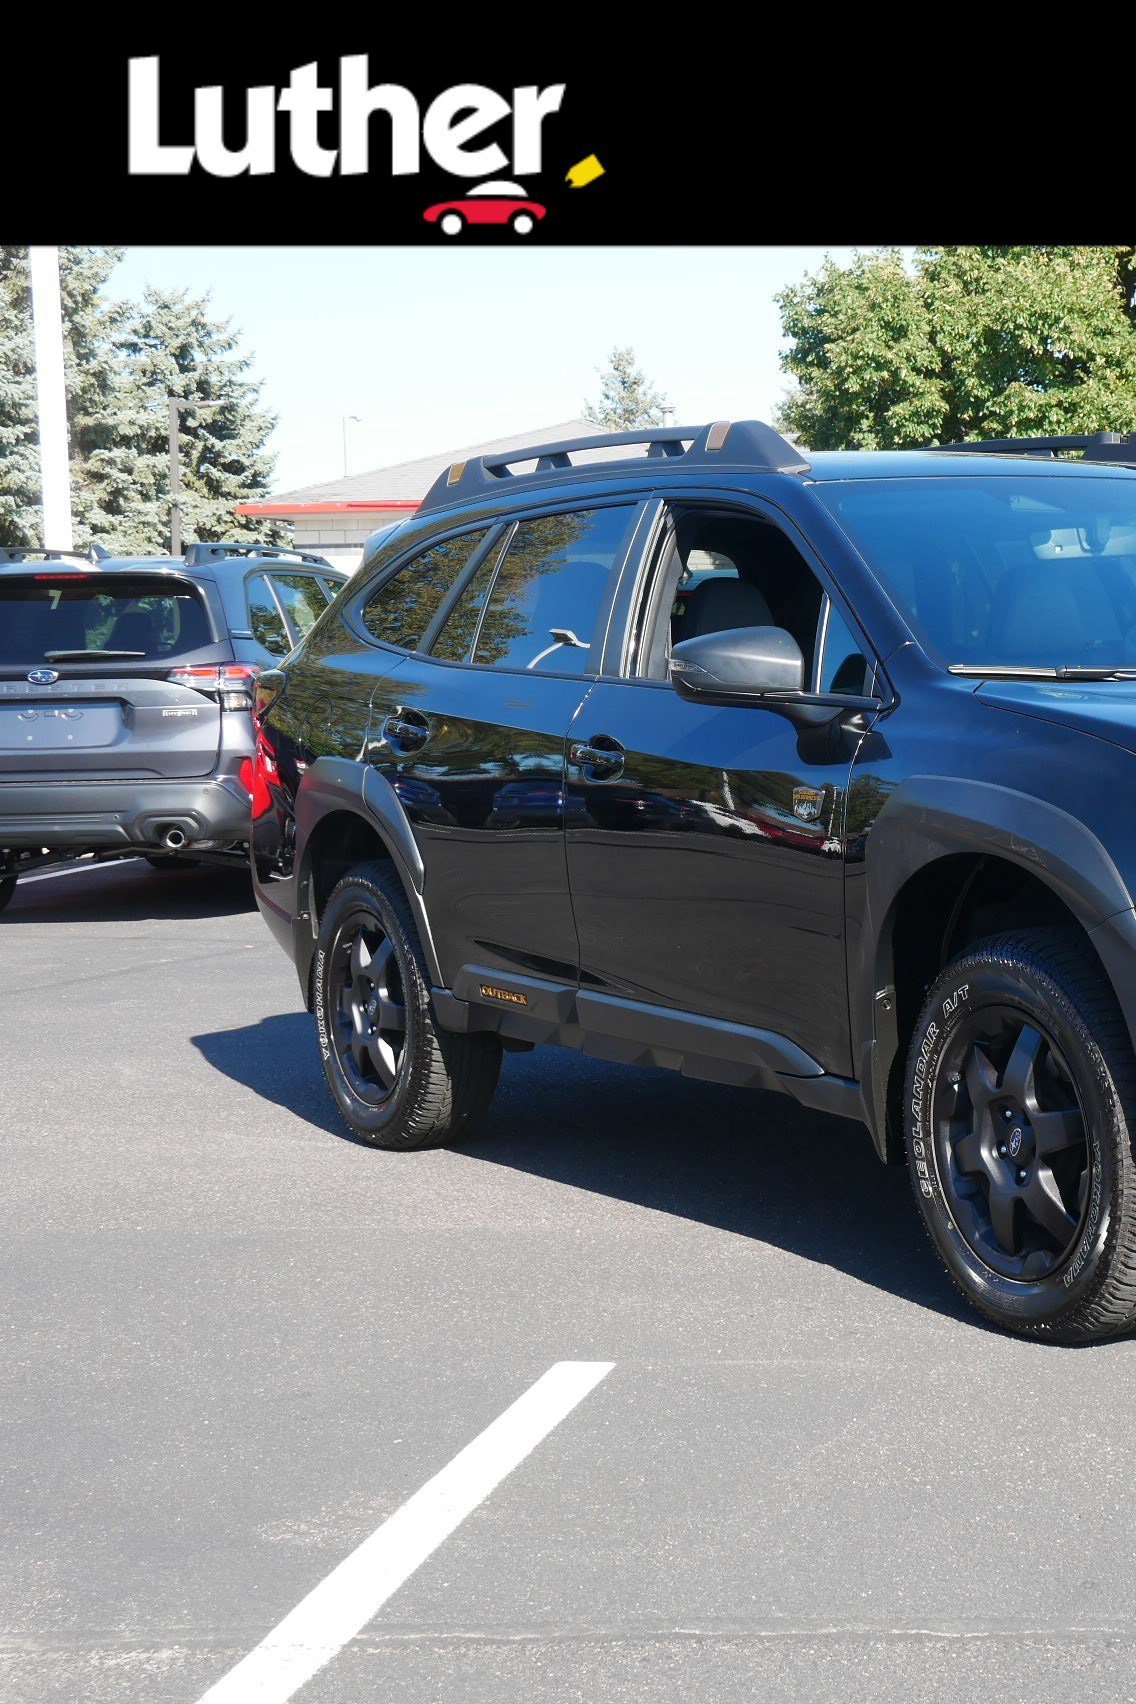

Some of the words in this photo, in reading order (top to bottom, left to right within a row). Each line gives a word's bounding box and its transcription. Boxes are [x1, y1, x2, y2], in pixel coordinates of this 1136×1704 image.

[481, 985, 528, 1005] OUTBACK
[911, 1022, 940, 1199] GEOLANDAR
[943, 984, 970, 1019] A/T
